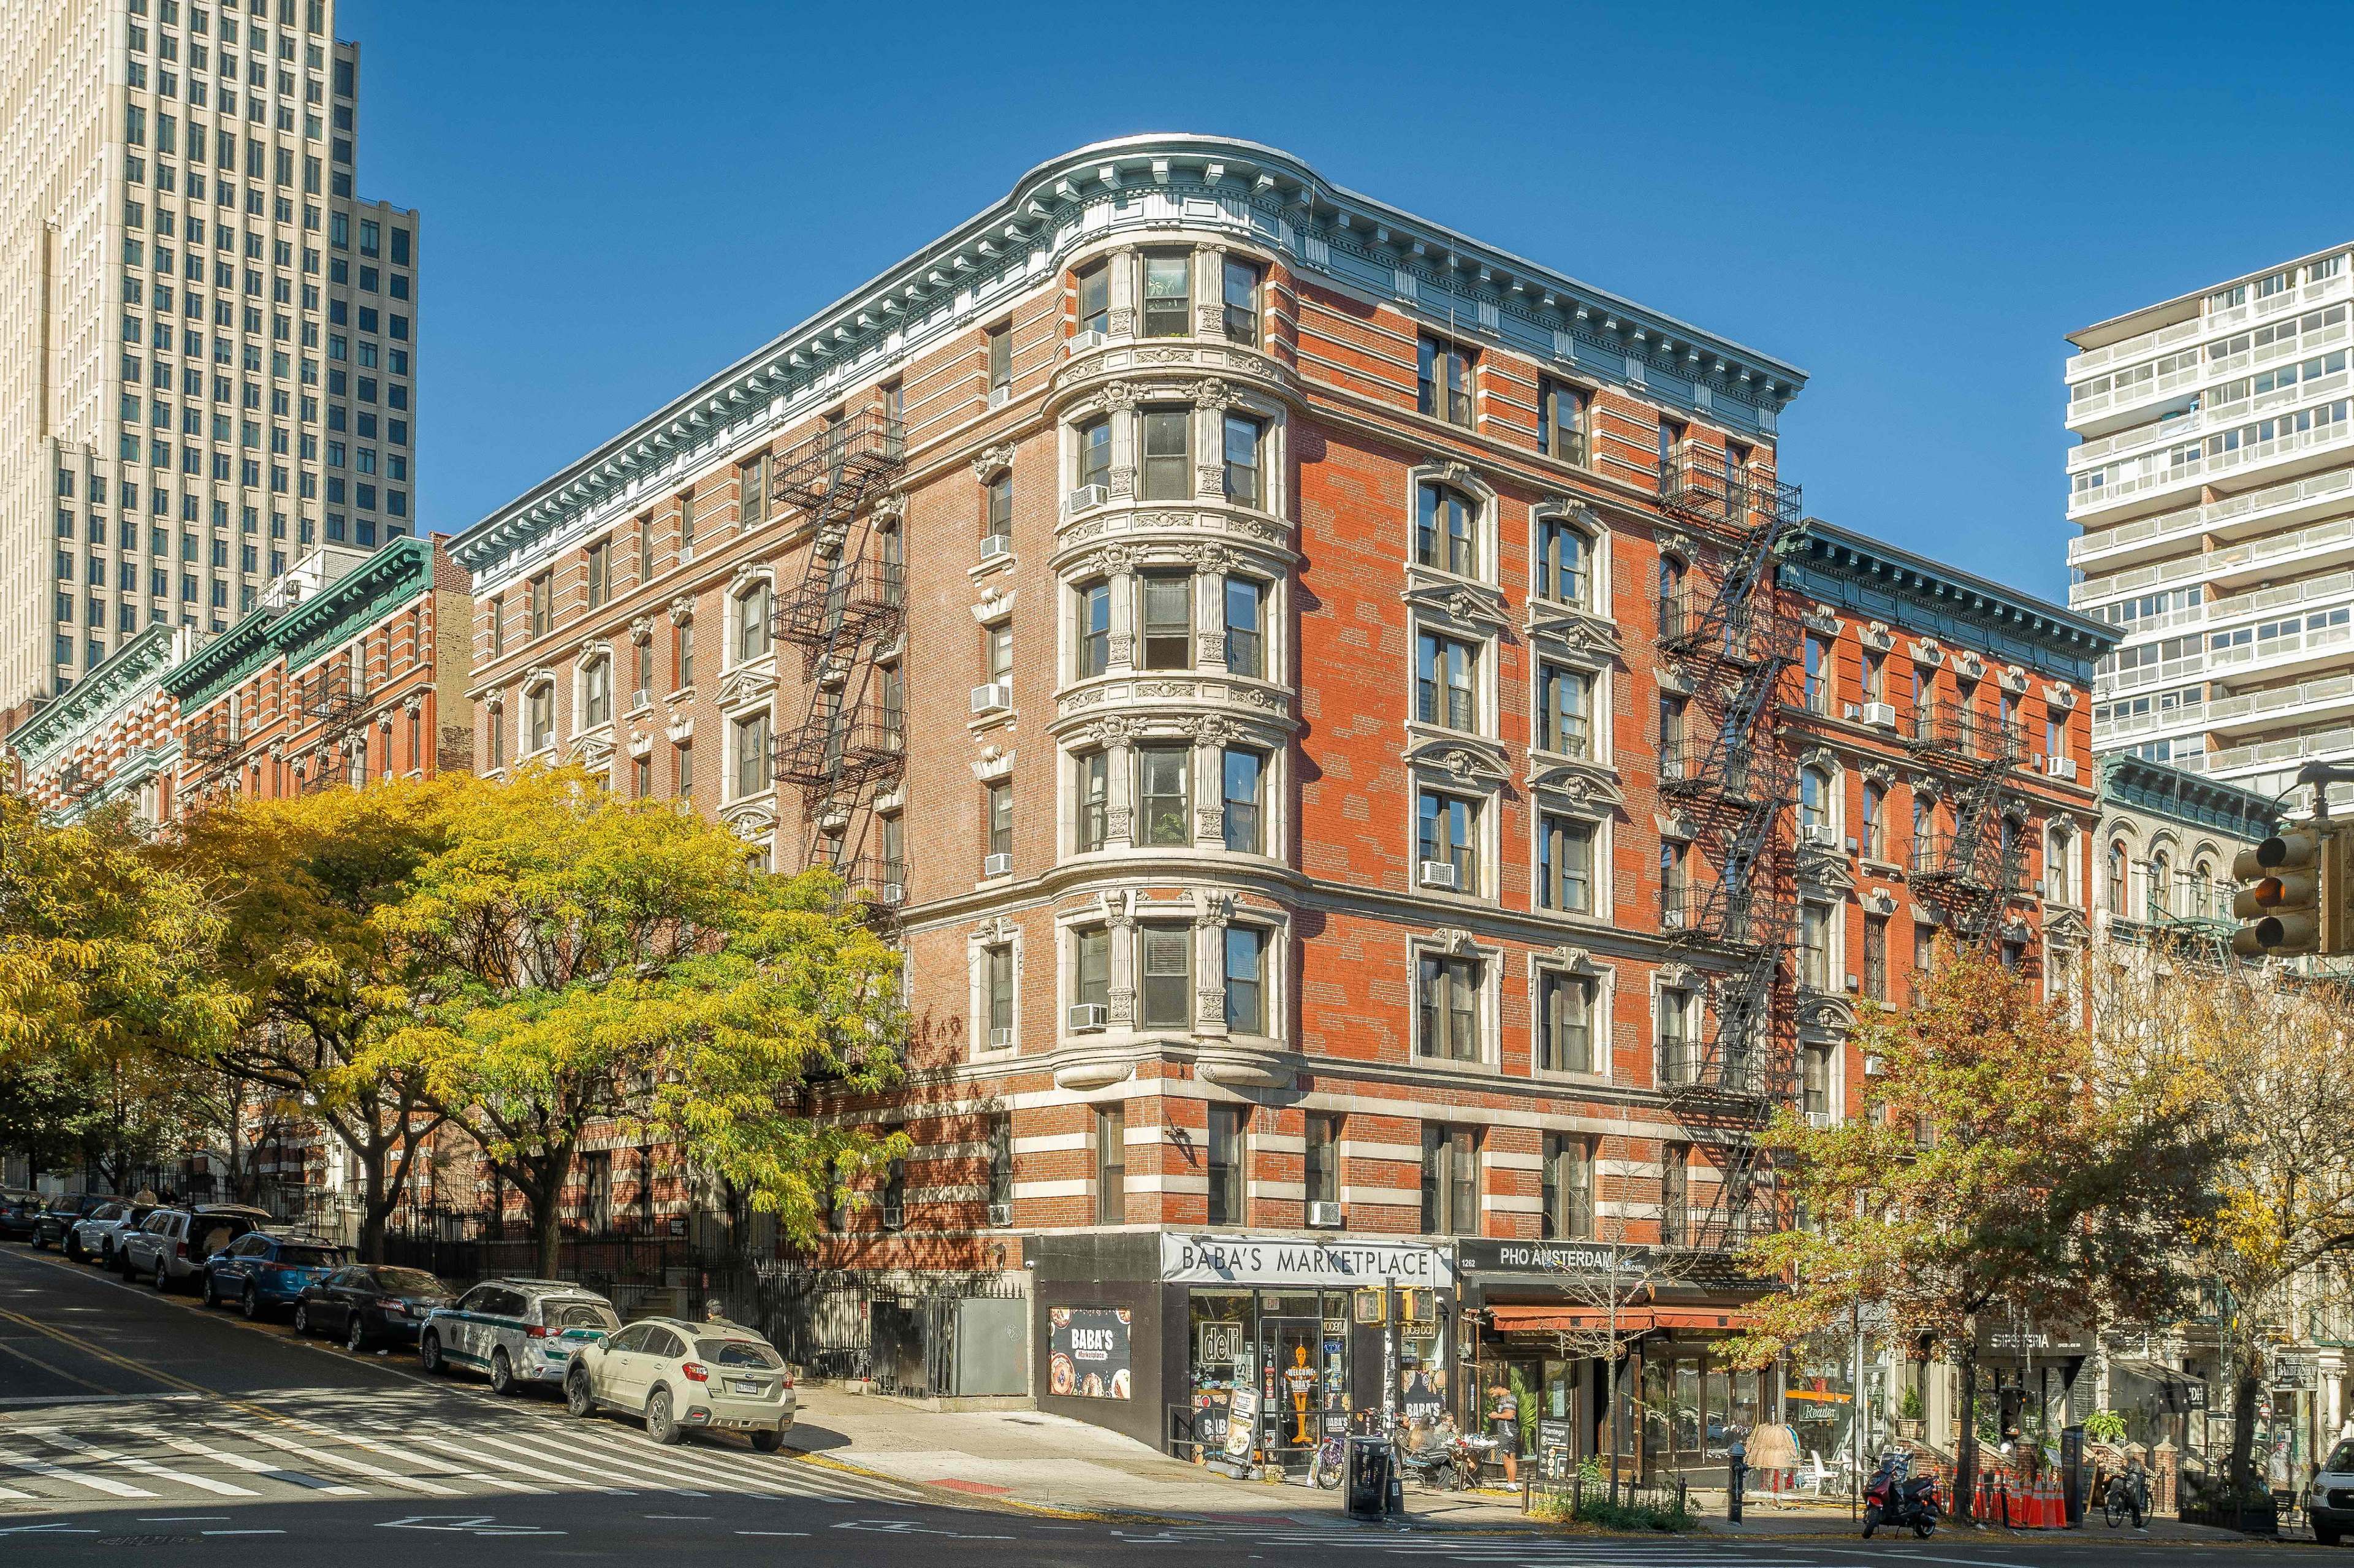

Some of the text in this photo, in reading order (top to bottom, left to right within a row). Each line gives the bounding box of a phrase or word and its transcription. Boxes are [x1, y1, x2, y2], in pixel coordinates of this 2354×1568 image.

[1183, 1246, 1428, 1276] BABA'S MARKETPLACE
[1461, 1259, 1476, 1268] 1262
[1500, 1248, 1613, 1267] PHO AMSTERDAM
[1324, 1321, 1345, 1333] rocery
[1072, 1328, 1113, 1350] BABA'S
[1205, 1327, 1239, 1360] deli
[1406, 1402, 1440, 1417] BABA'S
[1804, 1404, 1836, 1418] Reader
[1542, 1427, 1565, 1437] Plantega
